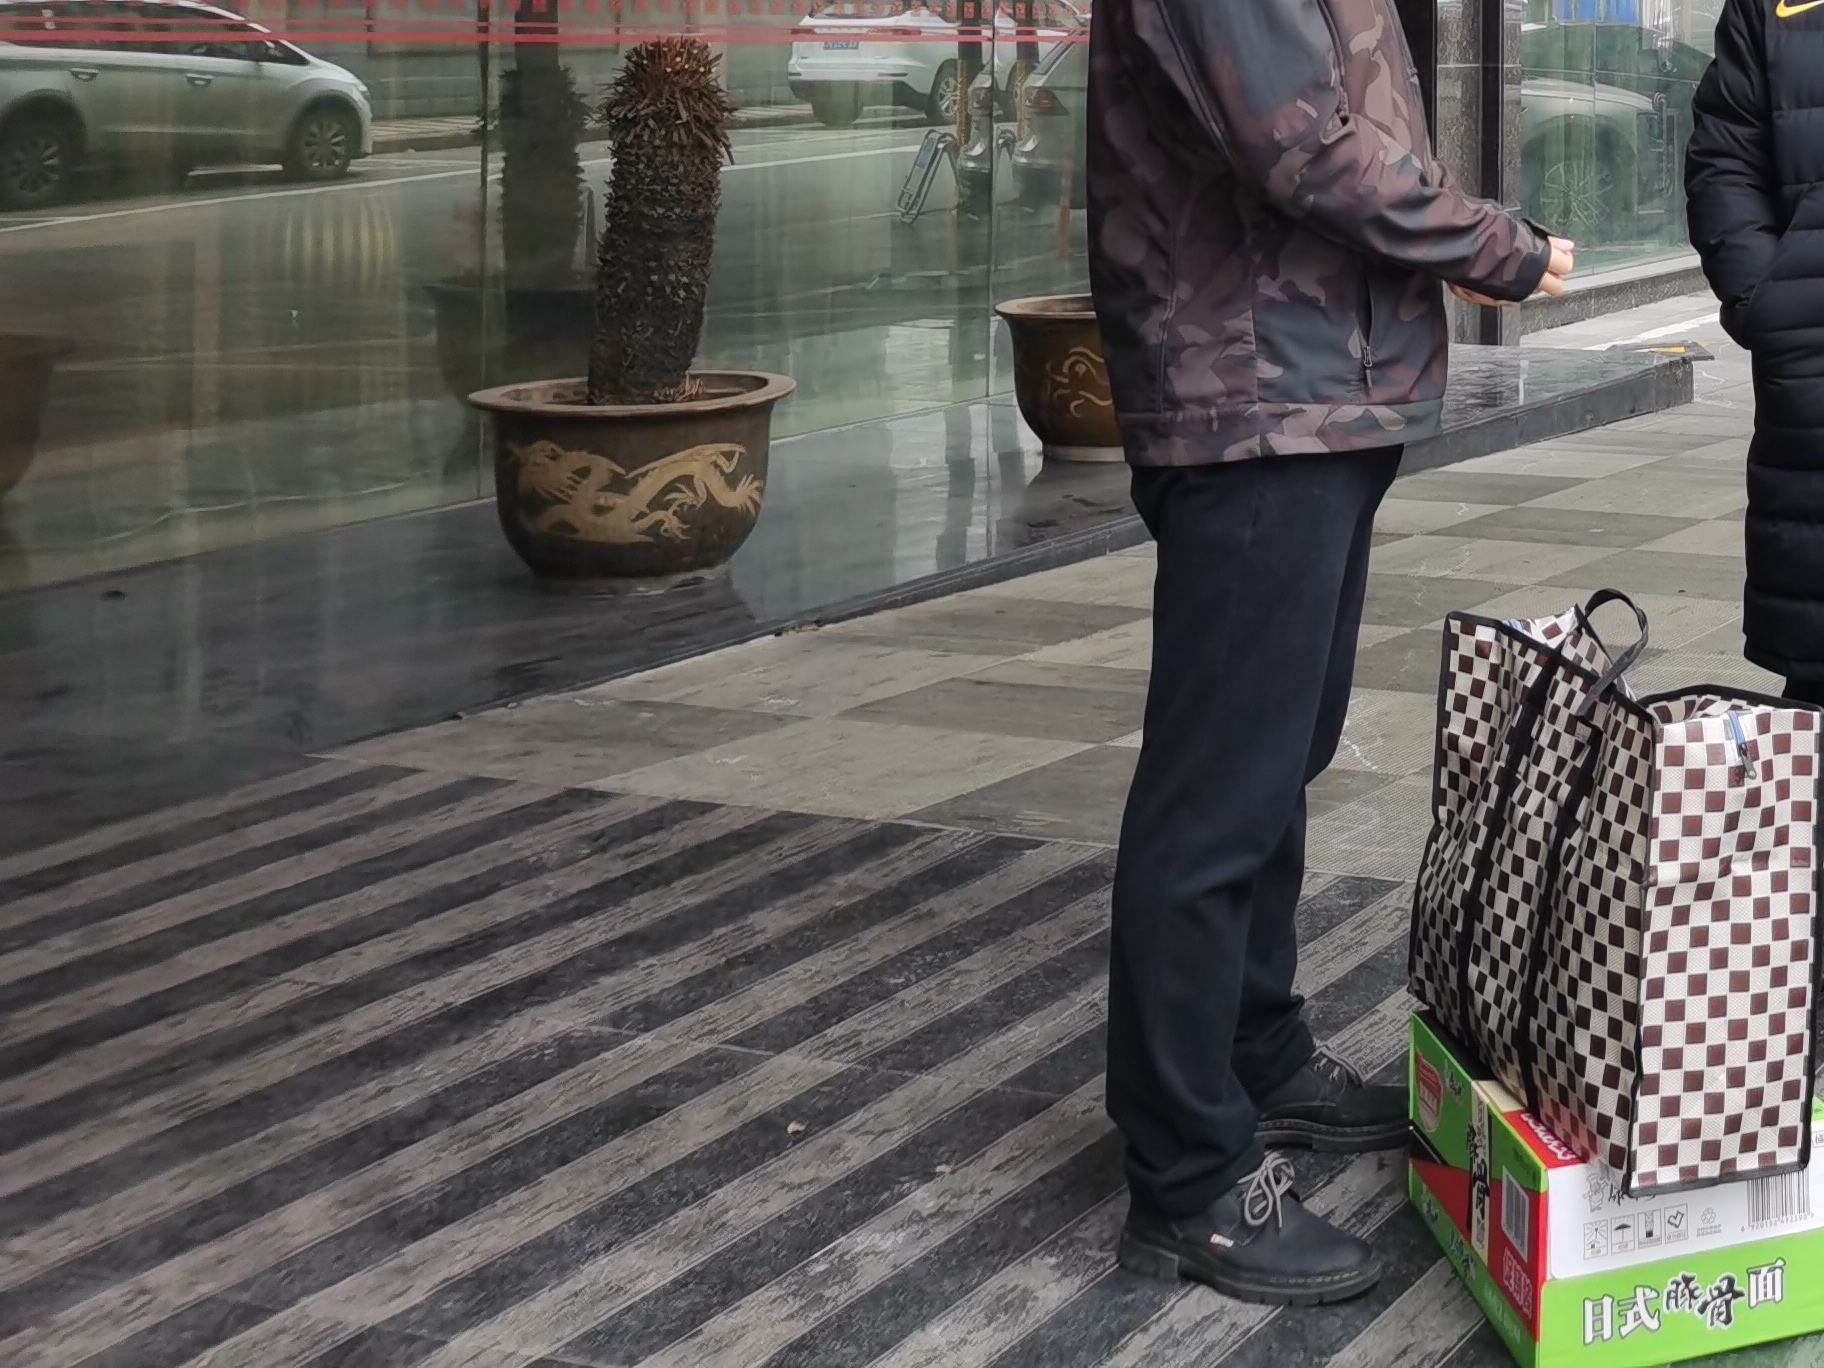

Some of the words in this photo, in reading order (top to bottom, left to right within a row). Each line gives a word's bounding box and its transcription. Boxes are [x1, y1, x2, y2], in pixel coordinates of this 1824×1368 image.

[1583, 1257, 1786, 1346] 日式豚骨面
